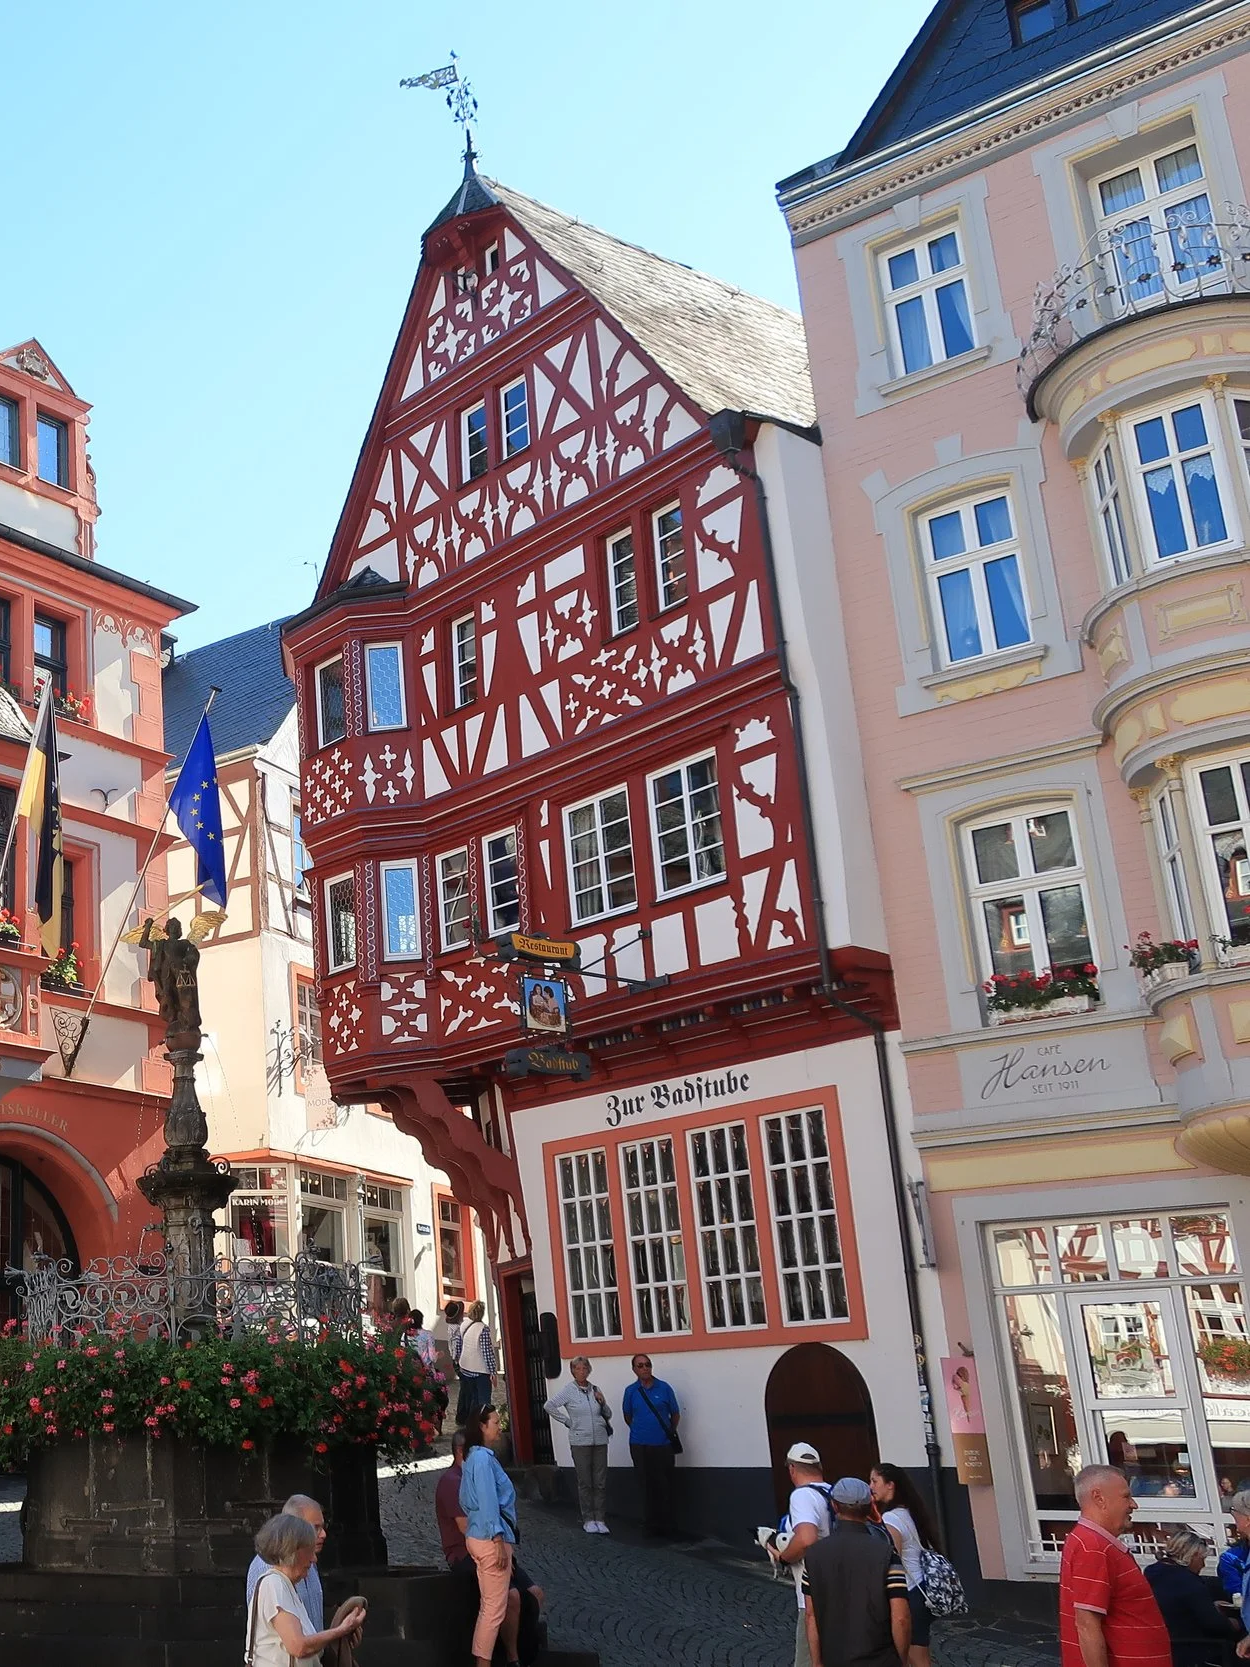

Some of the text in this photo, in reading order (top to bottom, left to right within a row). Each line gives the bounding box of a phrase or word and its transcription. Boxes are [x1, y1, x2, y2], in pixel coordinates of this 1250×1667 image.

[518, 937, 570, 956] Restaurant
[981, 1046, 1111, 1100] Hansen
[1032, 1080, 1080, 1095] SEIT 1911
[604, 1095, 645, 1127] Zur
[231, 1198, 259, 1207] KARIN
